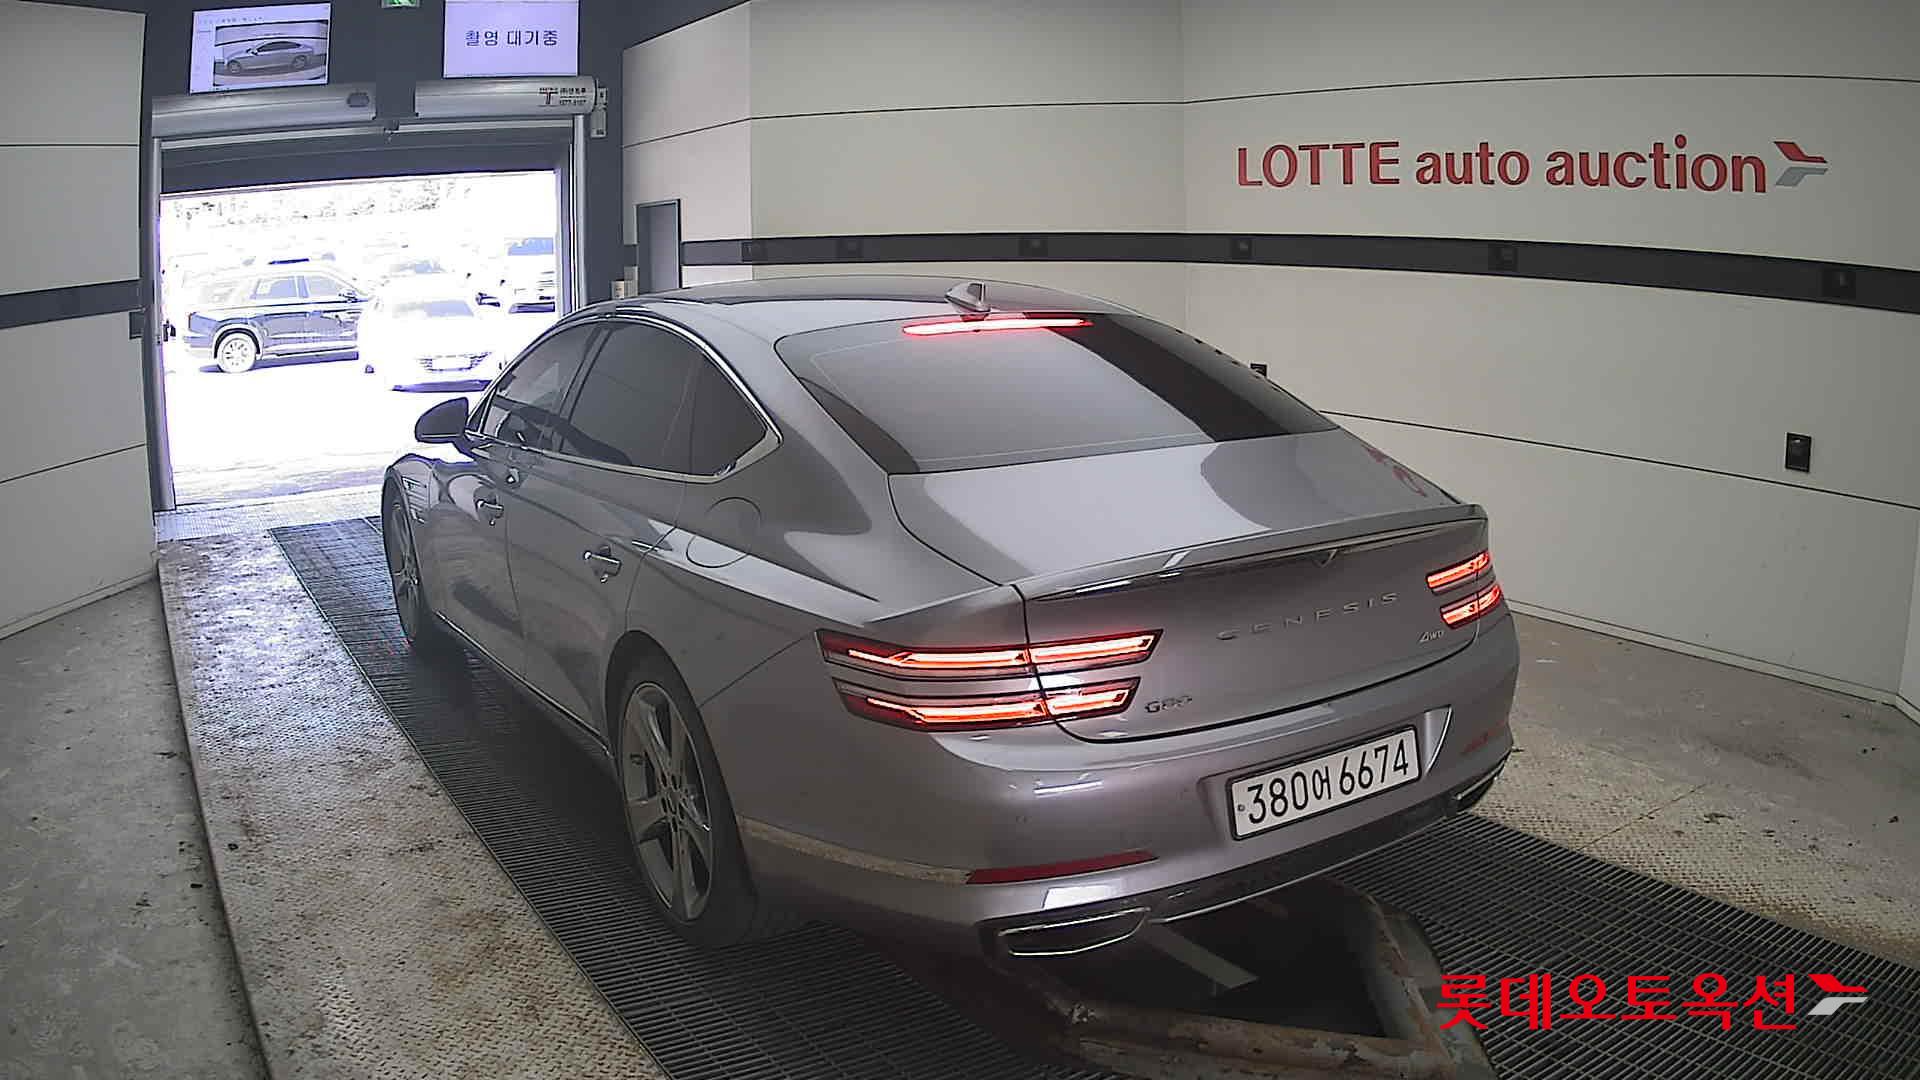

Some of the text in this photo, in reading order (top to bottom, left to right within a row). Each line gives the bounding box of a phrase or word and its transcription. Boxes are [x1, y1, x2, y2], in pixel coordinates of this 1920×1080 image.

[507, 29, 558, 47] 대기중
[1237, 133, 1767, 194] LOTTE auto auction
